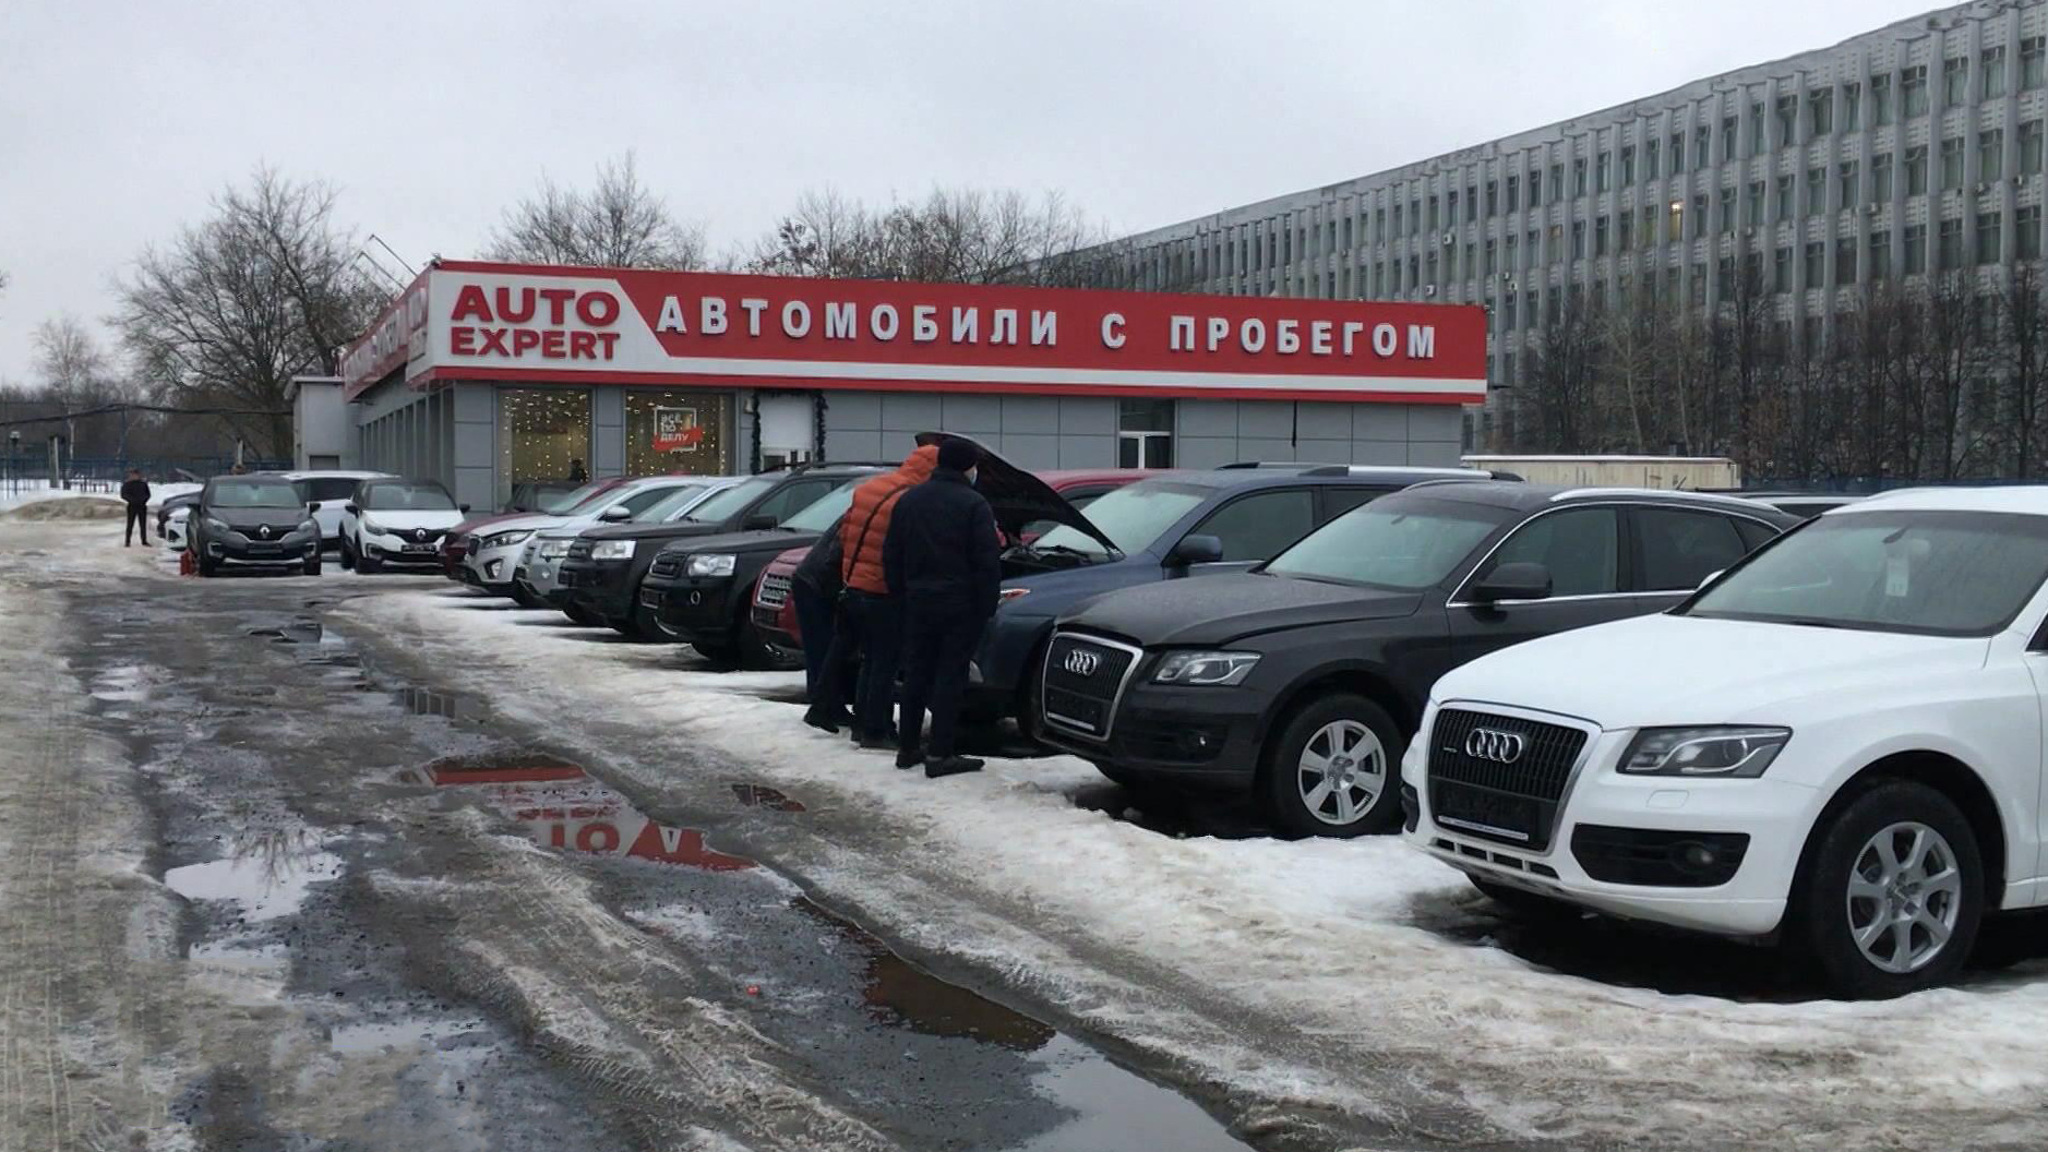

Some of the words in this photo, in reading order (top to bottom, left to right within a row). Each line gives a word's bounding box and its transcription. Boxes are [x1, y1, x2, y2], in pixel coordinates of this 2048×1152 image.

[451, 285, 620, 327] AUTO
[450, 326, 621, 361] EXPERT
[656, 296, 1057, 346] АВТОМОБИЛИ
[1101, 313, 1126, 349] С
[1170, 315, 1435, 359] ПРОБЕГОМ
